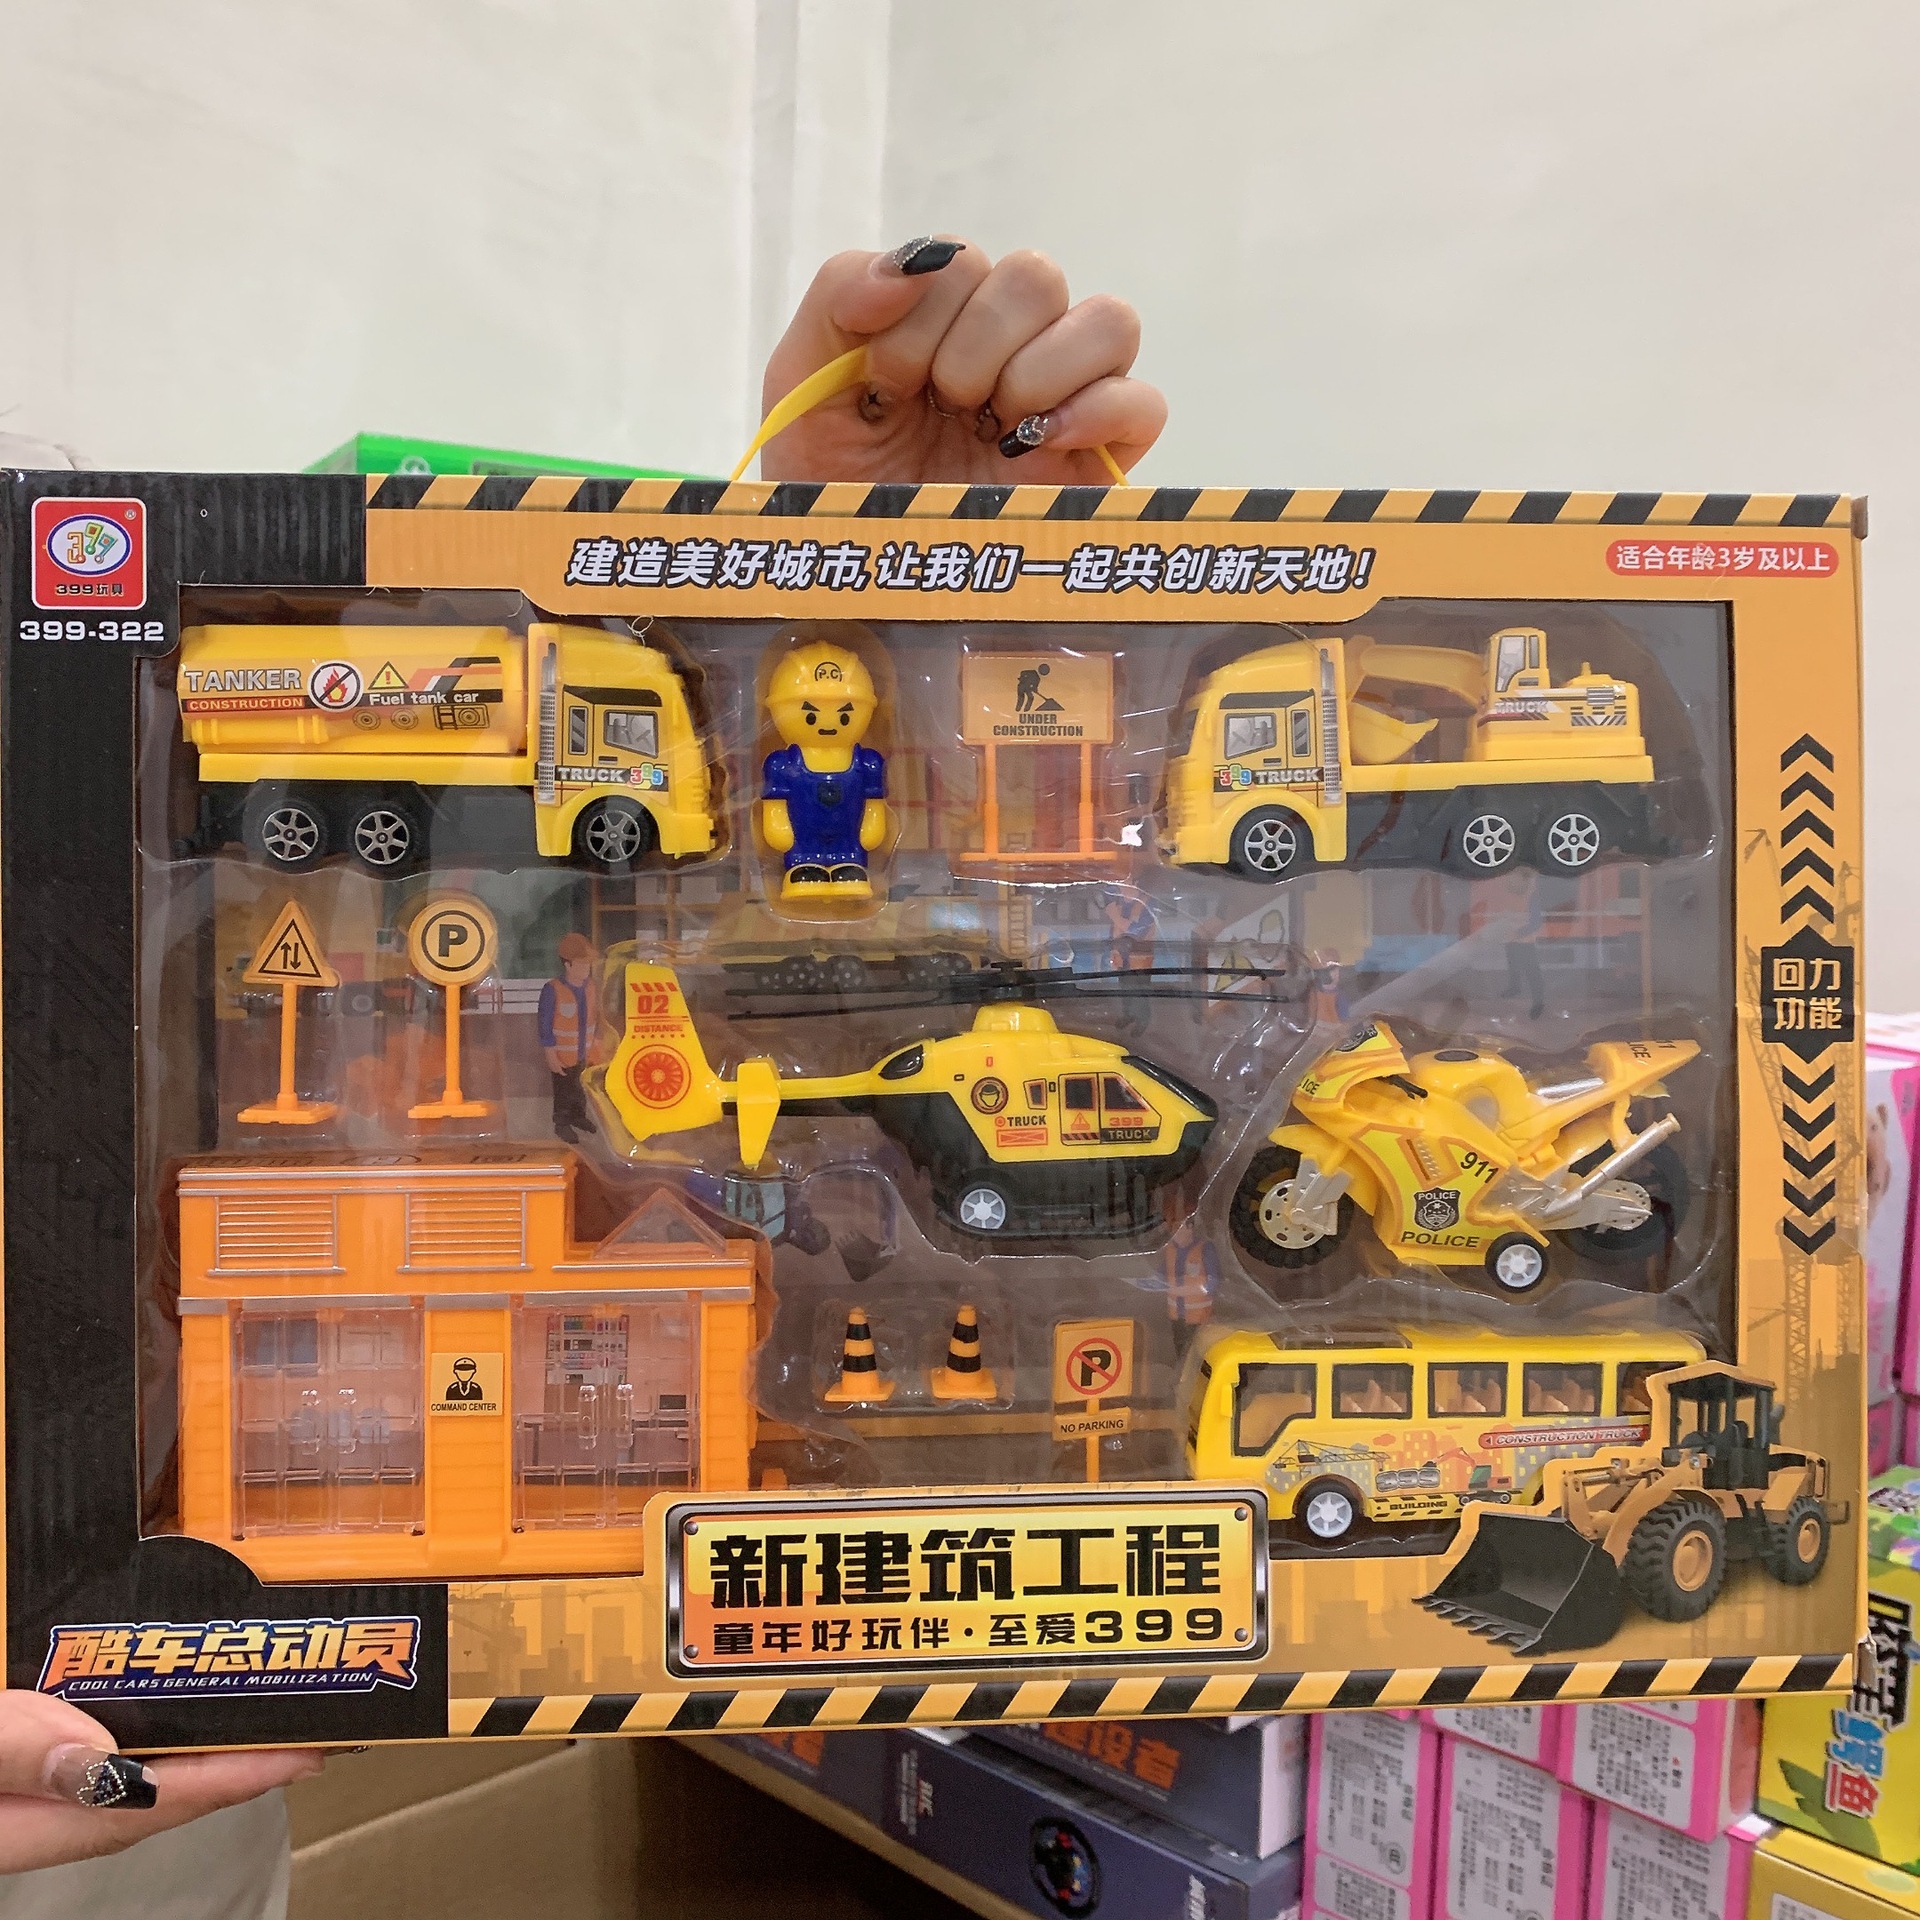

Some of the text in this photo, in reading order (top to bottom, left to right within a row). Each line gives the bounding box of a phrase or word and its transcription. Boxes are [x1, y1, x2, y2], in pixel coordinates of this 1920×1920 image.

[564, 537, 1374, 593] 建造美好城市,让我们一起共创新天地!
[1616, 545, 1831, 571] 适合年龄3岁及以上
[56, 583, 124, 597] 399玩具
[19, 620, 165, 642] 399-322
[184, 668, 303, 692] TANKER
[188, 697, 304, 712] CONSTRUCTION
[368, 691, 480, 706] Fuel tank car
[1494, 700, 1549, 714] TRUCK
[1018, 713, 1058, 725] UNDER
[992, 725, 1084, 737] CONSTRUCTION
[557, 763, 664, 785] TRUCK 399
[1219, 764, 1323, 786] 399 TRUCK
[438, 924, 468, 957] P
[1773, 957, 1842, 991] 回力
[637, 994, 669, 1015] 02
[1772, 997, 1843, 1030] 功能
[1006, 1115, 1047, 1127] TRUCK
[1109, 1116, 1144, 1127] 399
[1107, 1129, 1151, 1141] TRUCK
[1460, 1151, 1500, 1184] 911
[1417, 1190, 1457, 1200] POLICE
[1400, 1230, 1480, 1248] POLICE
[430, 1402, 497, 1412] COMMAND CENTER
[1060, 1418, 1124, 1434] NO PARKING
[1495, 1428, 1642, 1446] CONSTRUCTION TRUCK
[1389, 1500, 1448, 1511] BUILDING
[709, 1523, 1222, 1609] 新建筑工程
[712, 1607, 1224, 1654] 童年好玩伴·至爱399
[43, 1620, 416, 1691] 酷车总动员
[68, 1672, 373, 1692] COOL CARS GENERAL MOBILIZATION
